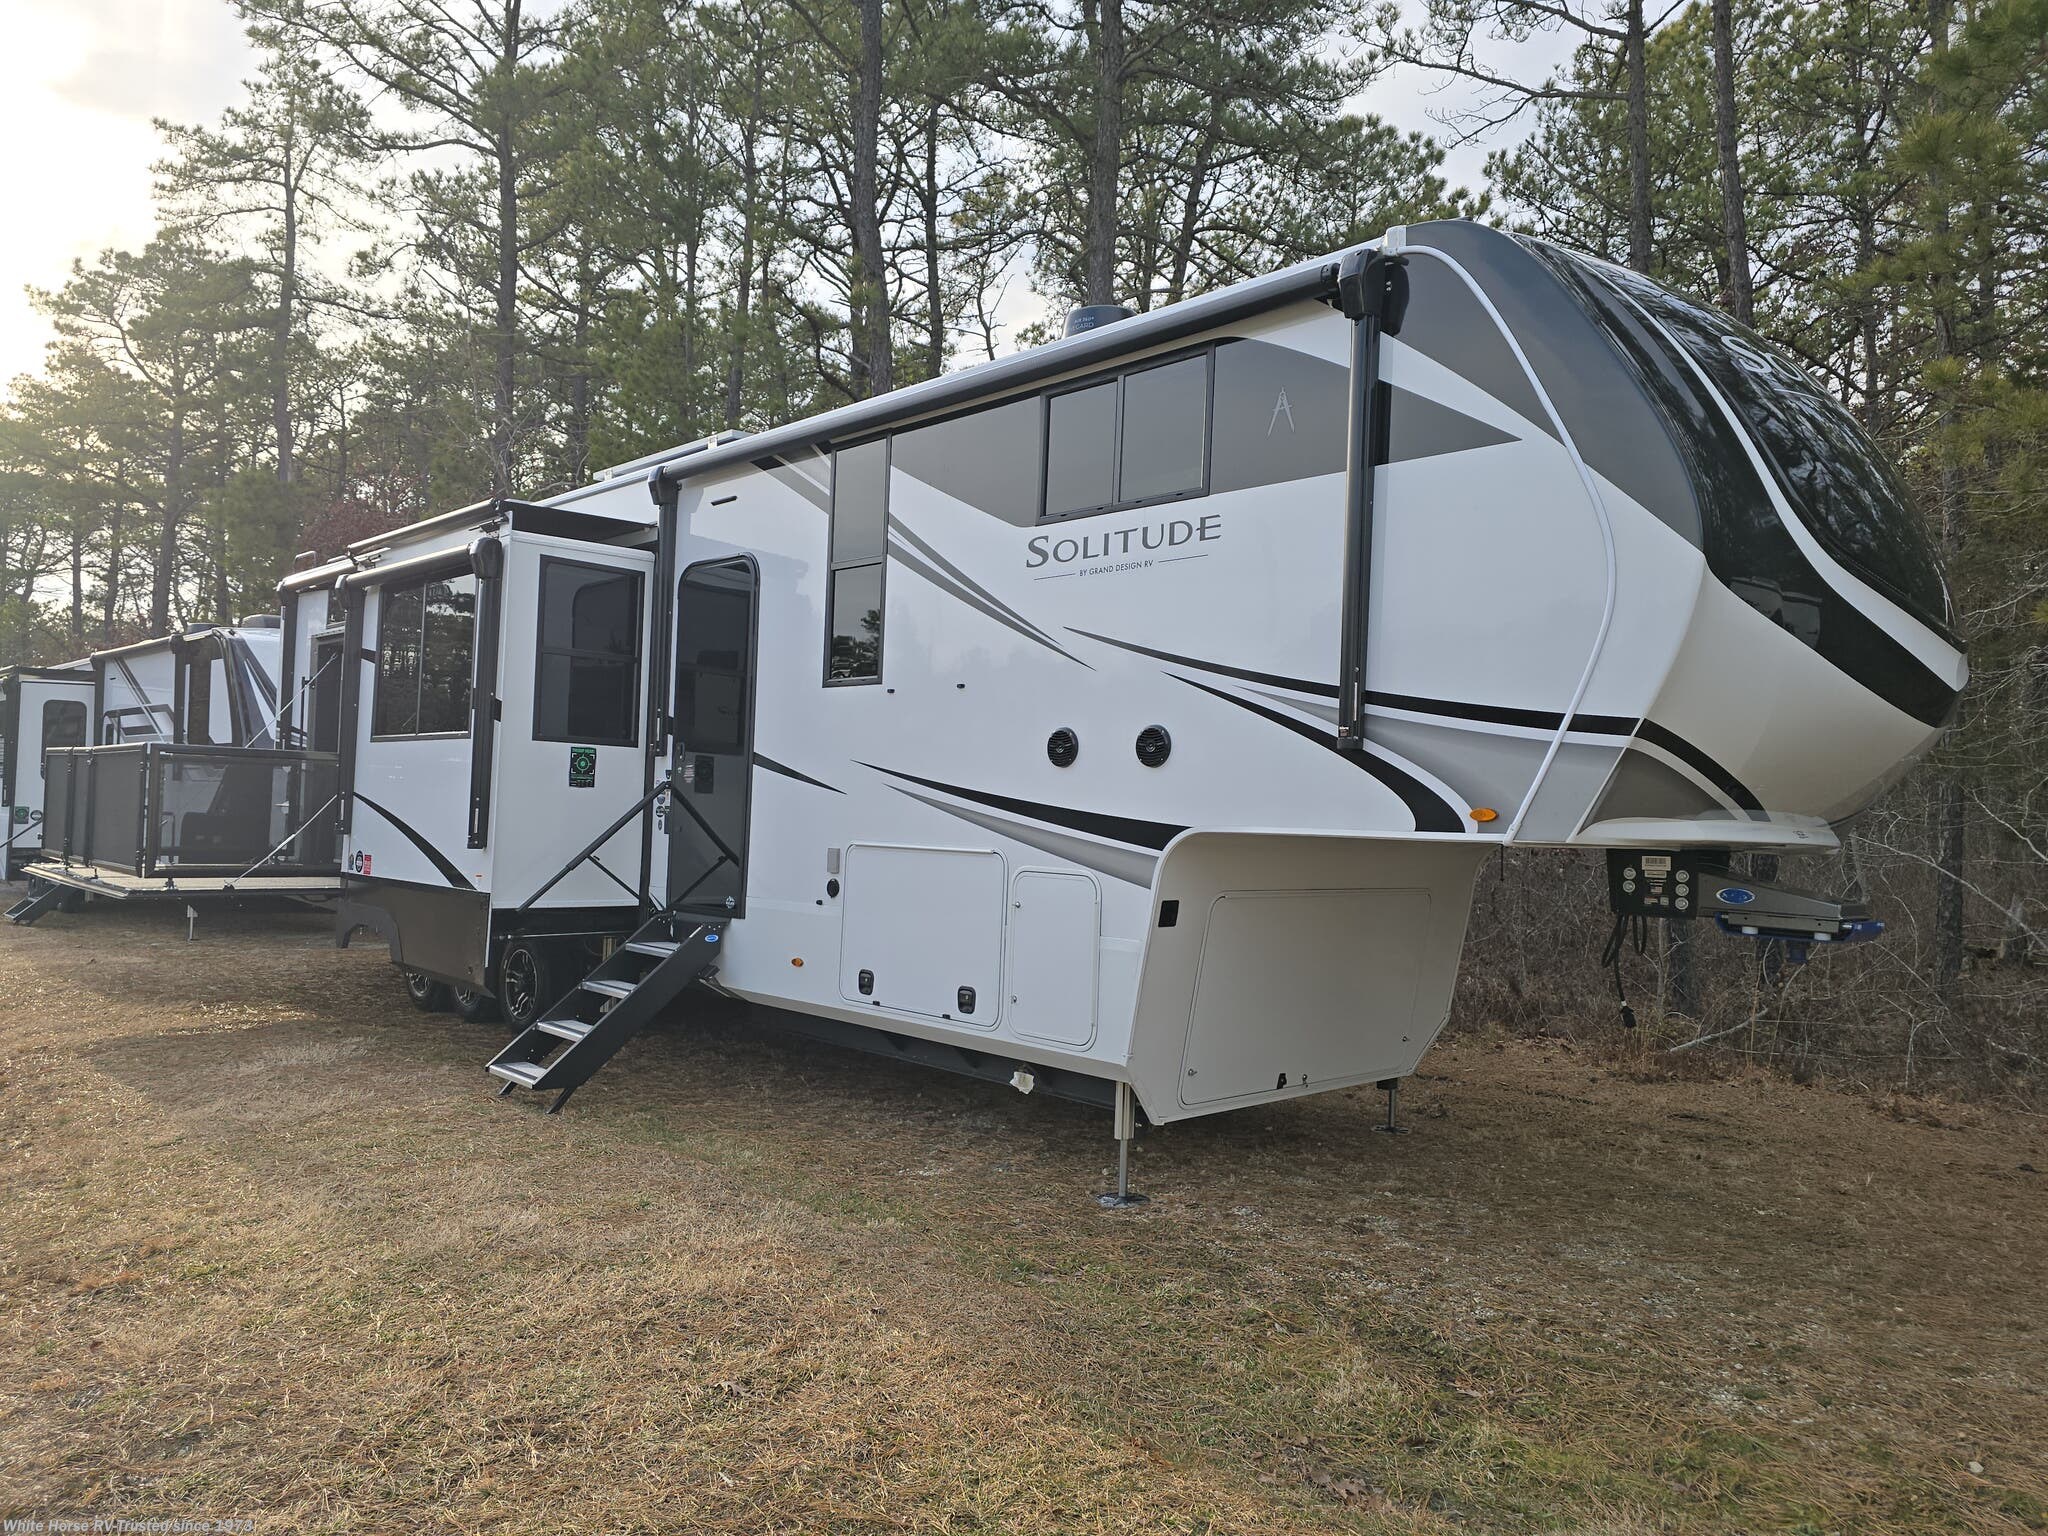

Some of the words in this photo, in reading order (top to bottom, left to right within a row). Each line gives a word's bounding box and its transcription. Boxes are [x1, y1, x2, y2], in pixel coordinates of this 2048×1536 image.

[1026, 514, 1222, 568] SOLITUDE
[1080, 569, 1088, 577] BY
[1089, 565, 1114, 576] GRAND
[1115, 561, 1142, 572] DESIGN
[1144, 560, 1154, 568] RV
